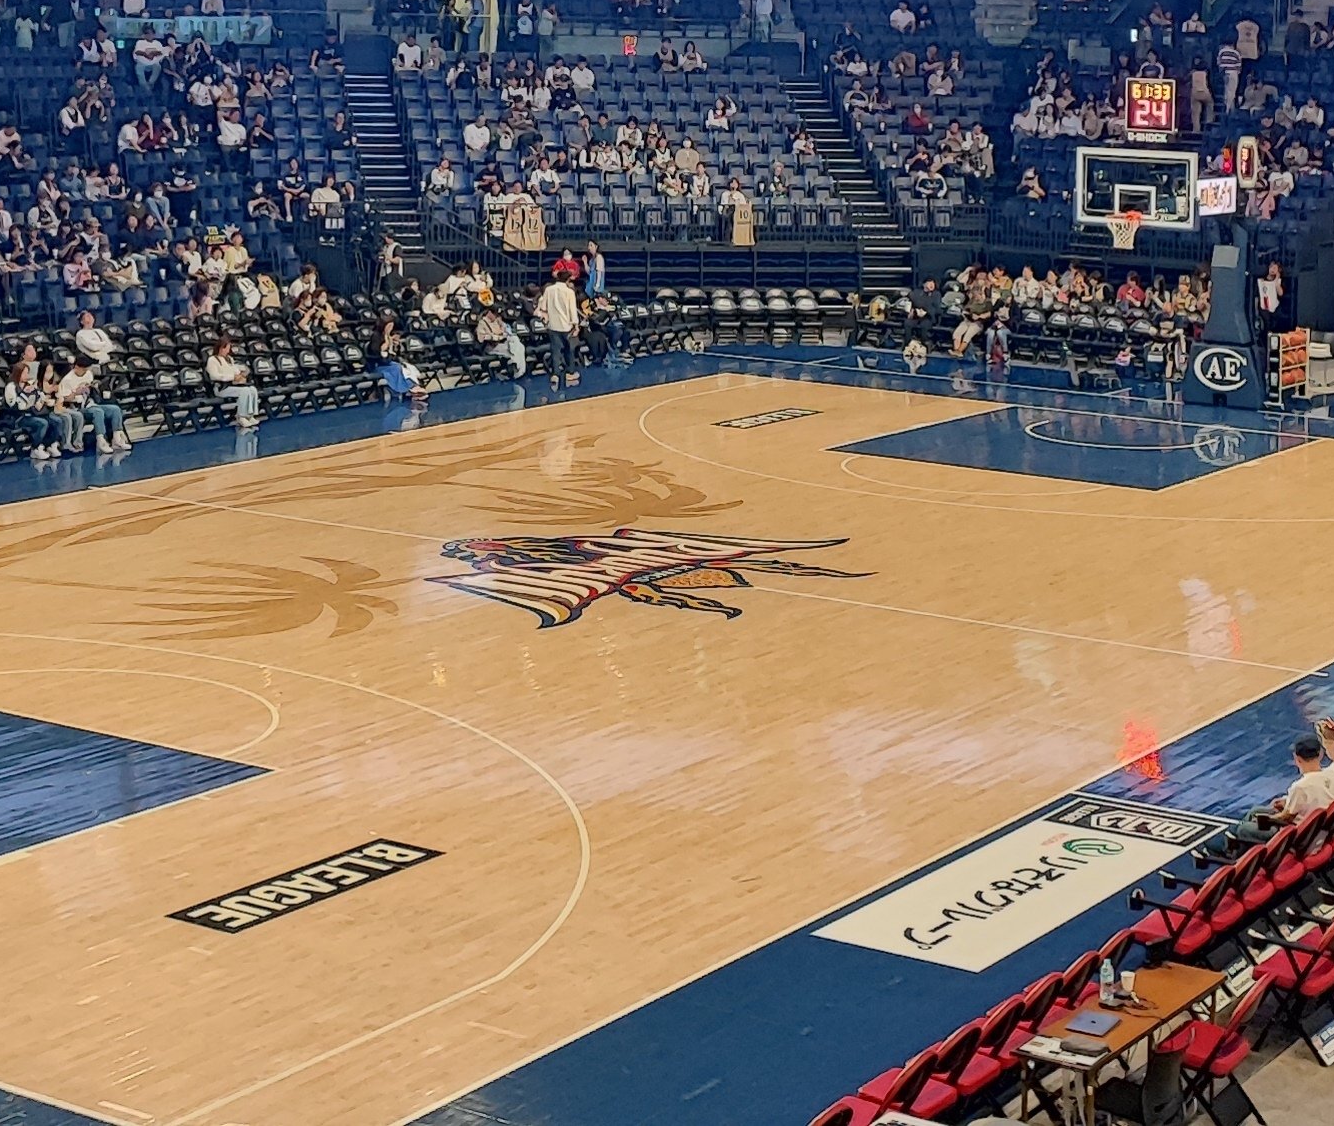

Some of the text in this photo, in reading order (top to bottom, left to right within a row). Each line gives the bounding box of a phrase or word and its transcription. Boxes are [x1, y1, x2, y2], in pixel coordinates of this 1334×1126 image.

[1137, 100, 1167, 126] 24
[739, 209, 748, 220] 10
[187, 841, 429, 928] B.LEAGUE
[903, 855, 1089, 951] りそなグループ
